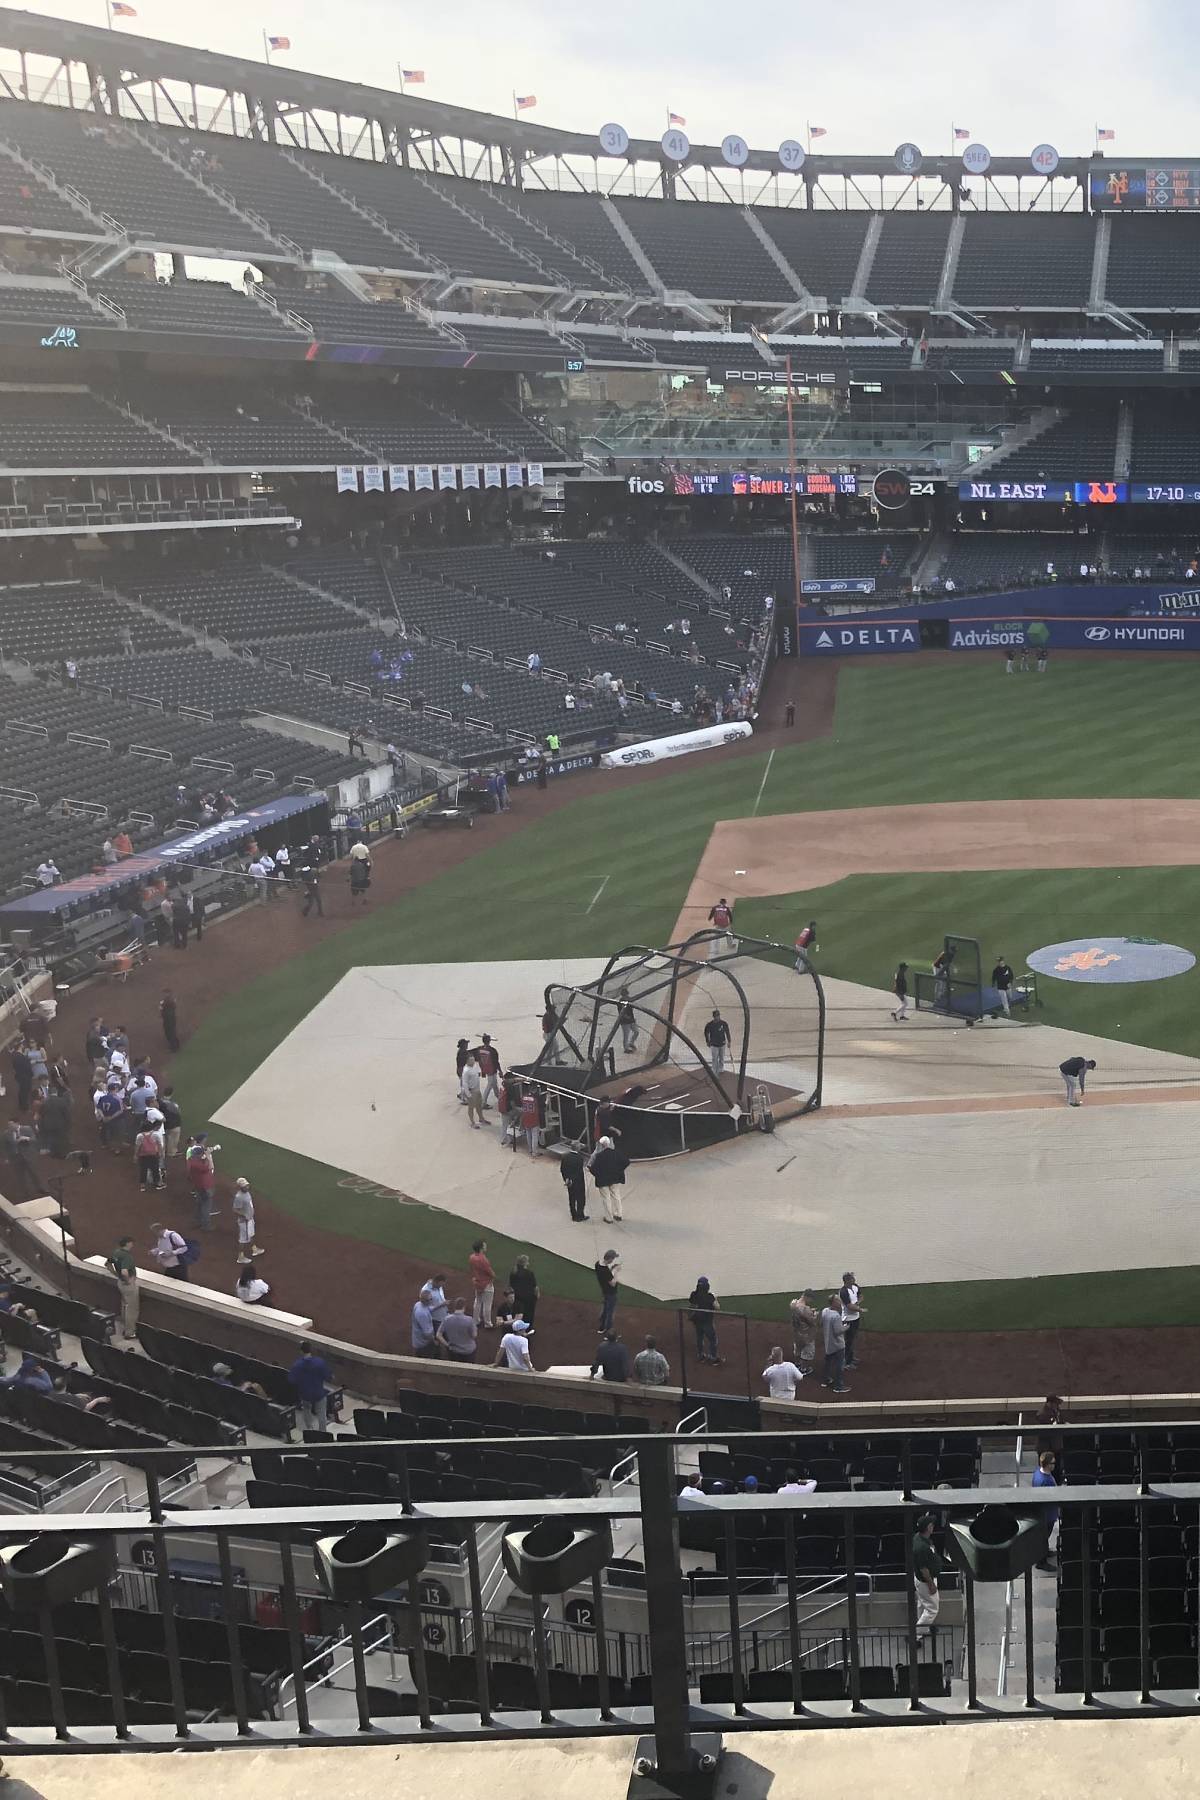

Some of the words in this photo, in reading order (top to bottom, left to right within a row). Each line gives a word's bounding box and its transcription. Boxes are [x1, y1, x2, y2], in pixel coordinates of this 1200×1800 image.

[607, 132, 621, 147] 31
[669, 138, 684, 152] 41
[728, 143, 741, 157] 14
[784, 148, 799, 162] 37
[1036, 152, 1053, 166] 42
[725, 370, 836, 383] PORSCHE
[628, 476, 664, 493] fios
[693, 475, 719, 483] ALL-TIME
[700, 484, 713, 493] K'S
[750, 481, 783, 493] SEAVER
[784, 482, 804, 493] 2,41
[910, 482, 936, 495] 24
[971, 484, 995, 498] NL
[1000, 484, 1046, 498] EAST
[1147, 487, 1183, 500] 17-10
[1064, 492, 1071, 501] 1
[994, 623, 1024, 631] BLOCK
[841, 629, 915, 645] DELTA
[952, 629, 1025, 647] Advisors
[1114, 628, 1184, 641] HYUNDAI
[567, 757, 593, 769] DELTA
[142, 1549, 155, 1566] 13
[426, 1588, 440, 1604] 13
[576, 1608, 591, 1625] 12
[428, 1628, 439, 1641] 12
